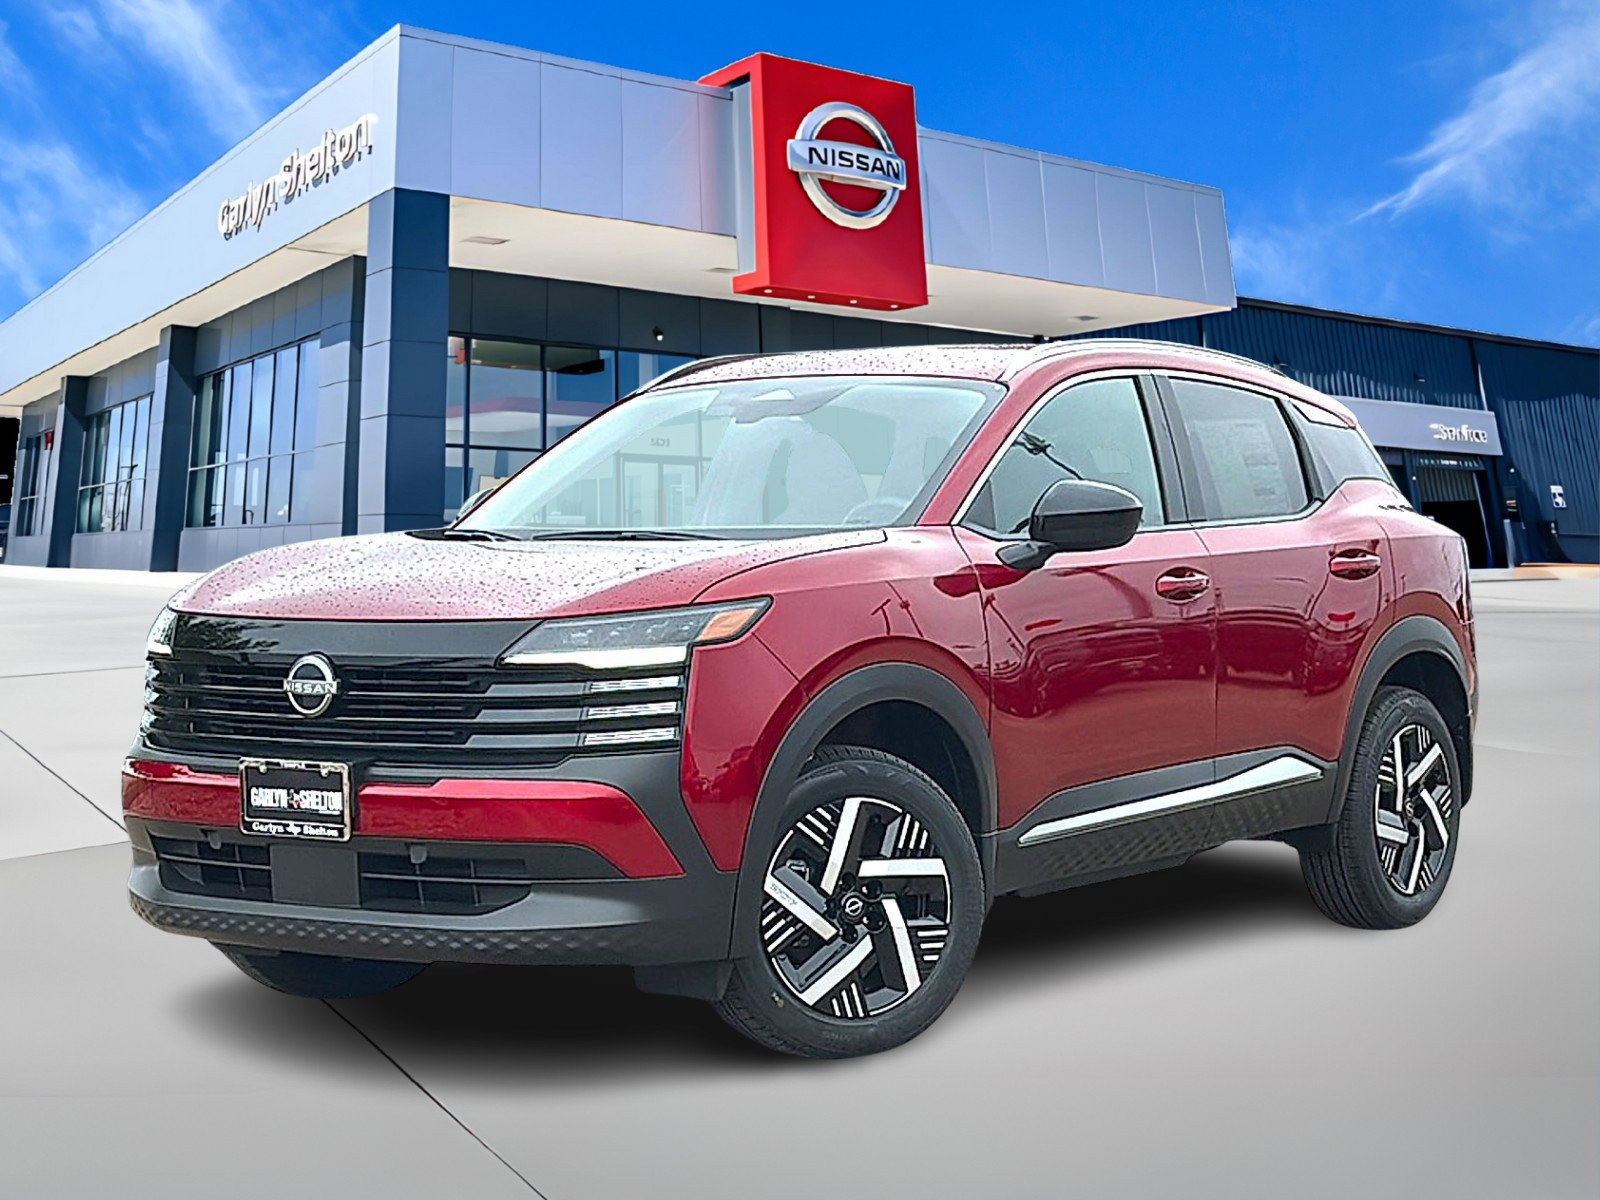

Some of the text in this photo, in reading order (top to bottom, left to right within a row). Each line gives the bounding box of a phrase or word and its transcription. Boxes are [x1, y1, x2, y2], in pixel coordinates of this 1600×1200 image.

[808, 146, 900, 181] NISSAN
[283, 680, 338, 694] NISSAN
[299, 789, 343, 811] SHELTON
